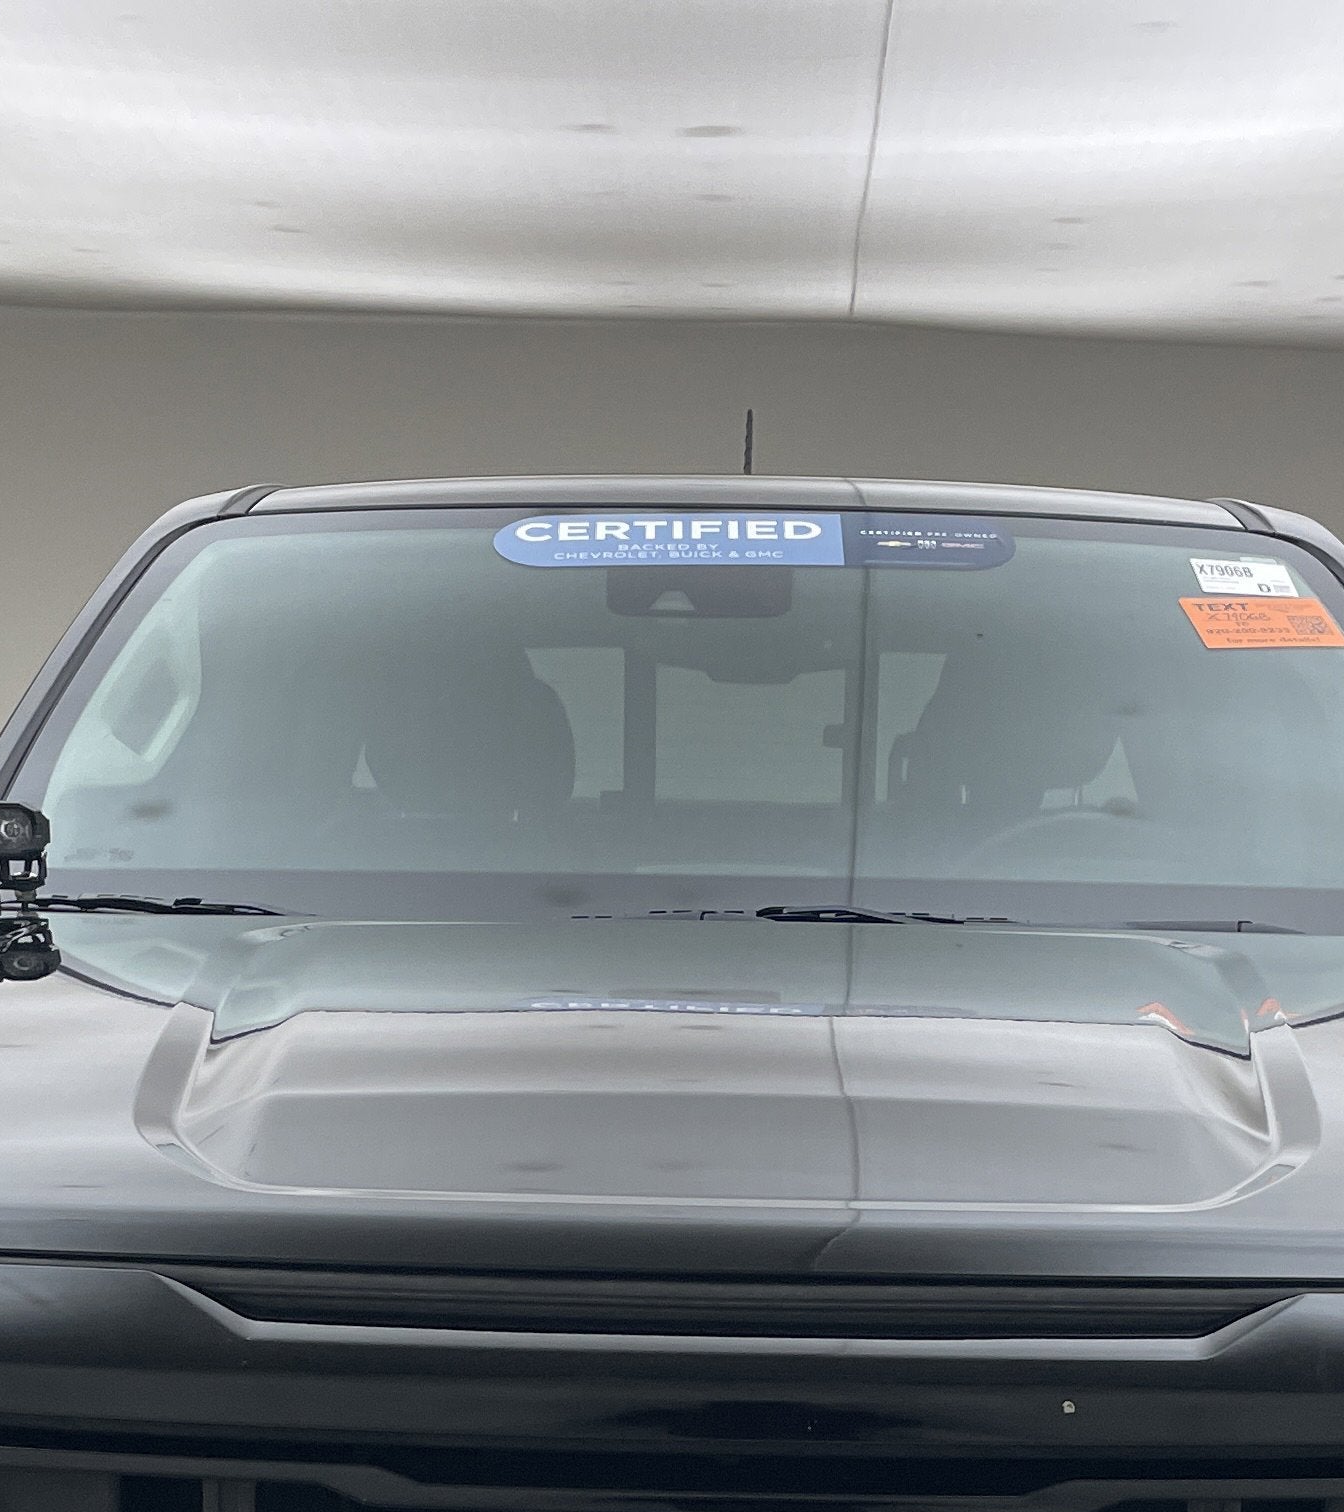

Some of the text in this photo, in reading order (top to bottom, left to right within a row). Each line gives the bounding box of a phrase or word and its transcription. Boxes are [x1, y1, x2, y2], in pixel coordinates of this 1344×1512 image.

[514, 519, 823, 542] CERTIFIED
[617, 543, 719, 552] BACKED BY
[668, 549, 723, 559] BUICK
[727, 550, 740, 559] &
[745, 550, 784, 559] GMC
[1197, 564, 1254, 578] X7906B
[1192, 602, 1249, 612] TEXT
